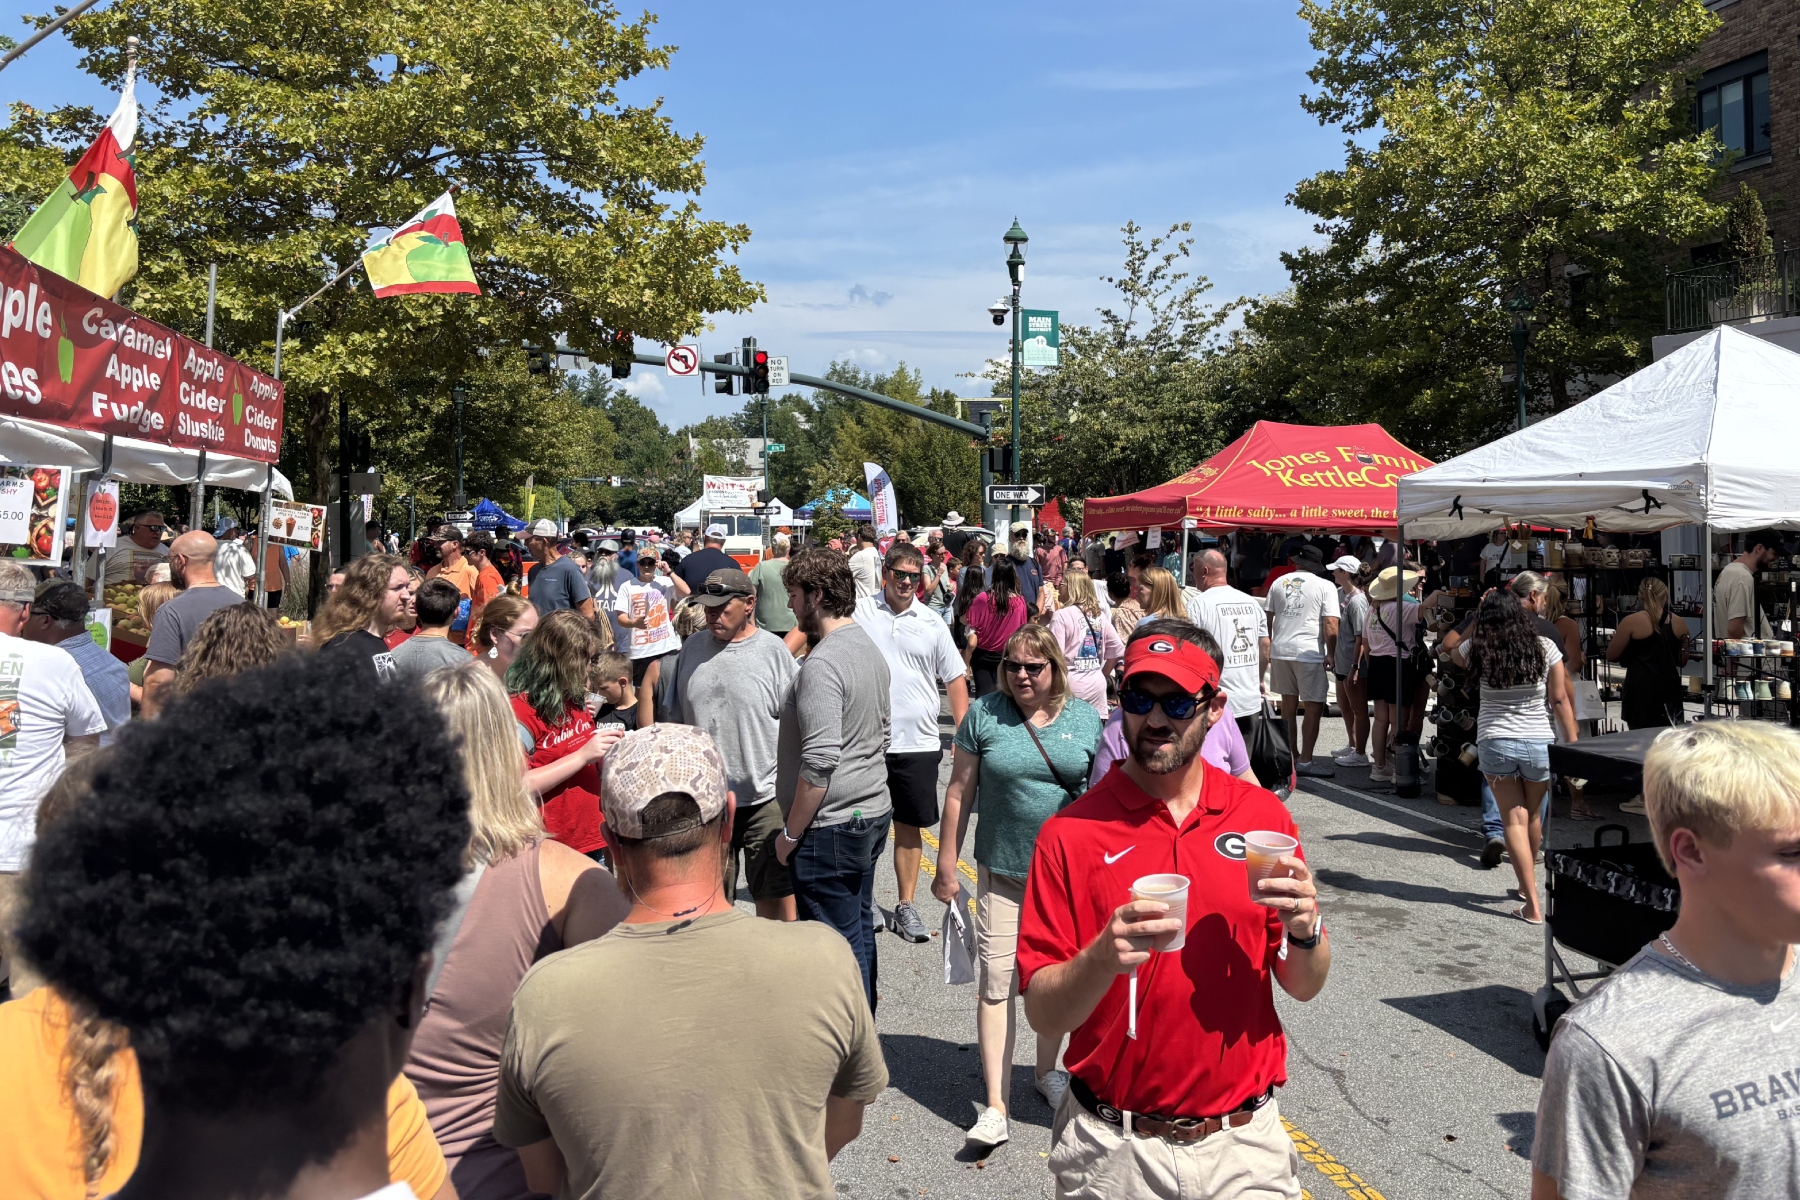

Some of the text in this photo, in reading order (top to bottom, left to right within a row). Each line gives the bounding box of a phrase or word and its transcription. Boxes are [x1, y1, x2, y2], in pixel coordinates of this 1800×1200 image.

[0, 281, 52, 339] ple
[82, 307, 172, 361] Caramel
[106, 354, 161, 392] Apple
[183, 348, 225, 383] Apple
[0, 361, 42, 405] es
[250, 376, 278, 400] Apple
[179, 382, 226, 414] Cider
[92, 391, 164, 433] Fudge
[245, 405, 277, 431] Cider
[178, 412, 225, 442] Slushie
[244, 428, 277, 453] Donuts
[1246, 451, 1331, 477] Jones
[873, 478, 883, 498] APPLE
[995, 491, 1029, 499] ONE WAY
[0, 510, 24, 521] 5.00
[876, 498, 887, 525] FESTIVAL
[1215, 505, 1243, 518] little
[1247, 505, 1287, 521] salty...
[1290, 510, 1298, 518] a
[1301, 506, 1329, 518] little
[1331, 508, 1368, 520] sweet,
[1371, 507, 1389, 518] the
[631, 593, 649, 646] CLSON
[1220, 605, 1254, 616] DISABLED
[1227, 653, 1257, 665] VETERAN
[542, 728, 574, 749] Cabin
